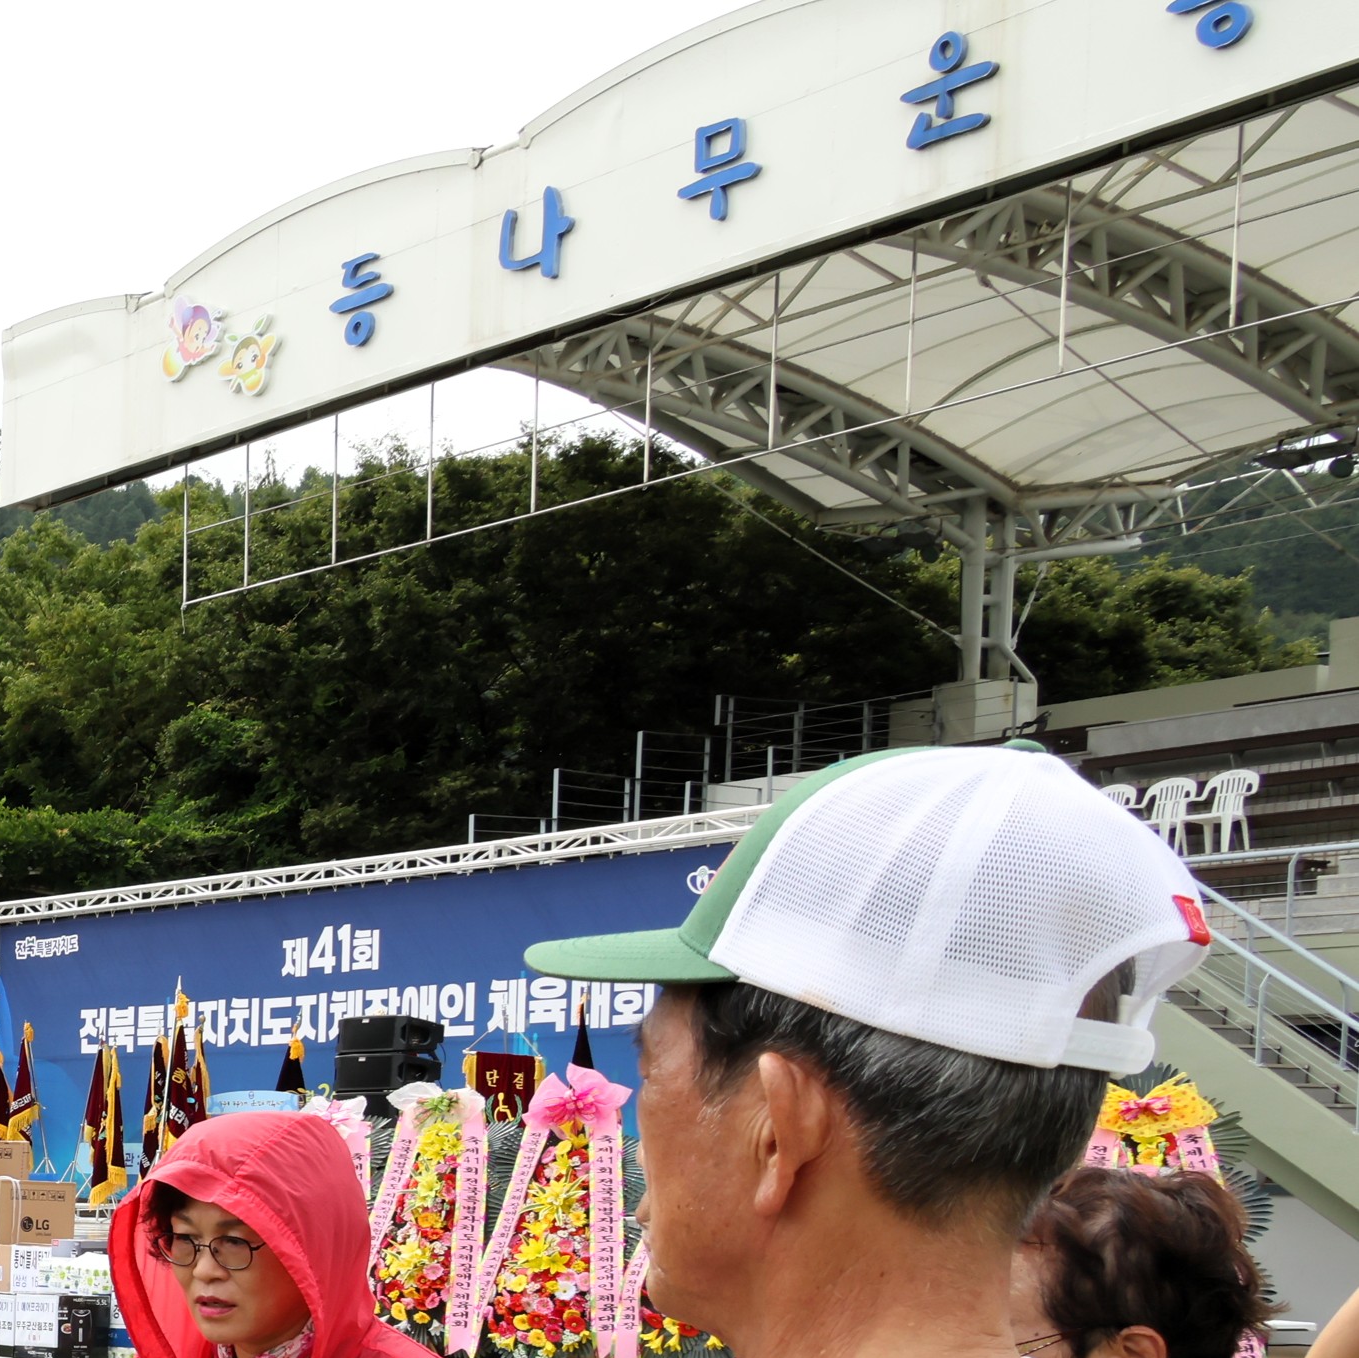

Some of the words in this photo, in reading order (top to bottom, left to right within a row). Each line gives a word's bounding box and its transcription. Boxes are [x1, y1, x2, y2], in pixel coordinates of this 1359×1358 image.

[15, 934, 79, 960] 전북특별자치도
[281, 923, 381, 977] 제41회
[487, 976, 655, 1033] 체육대회
